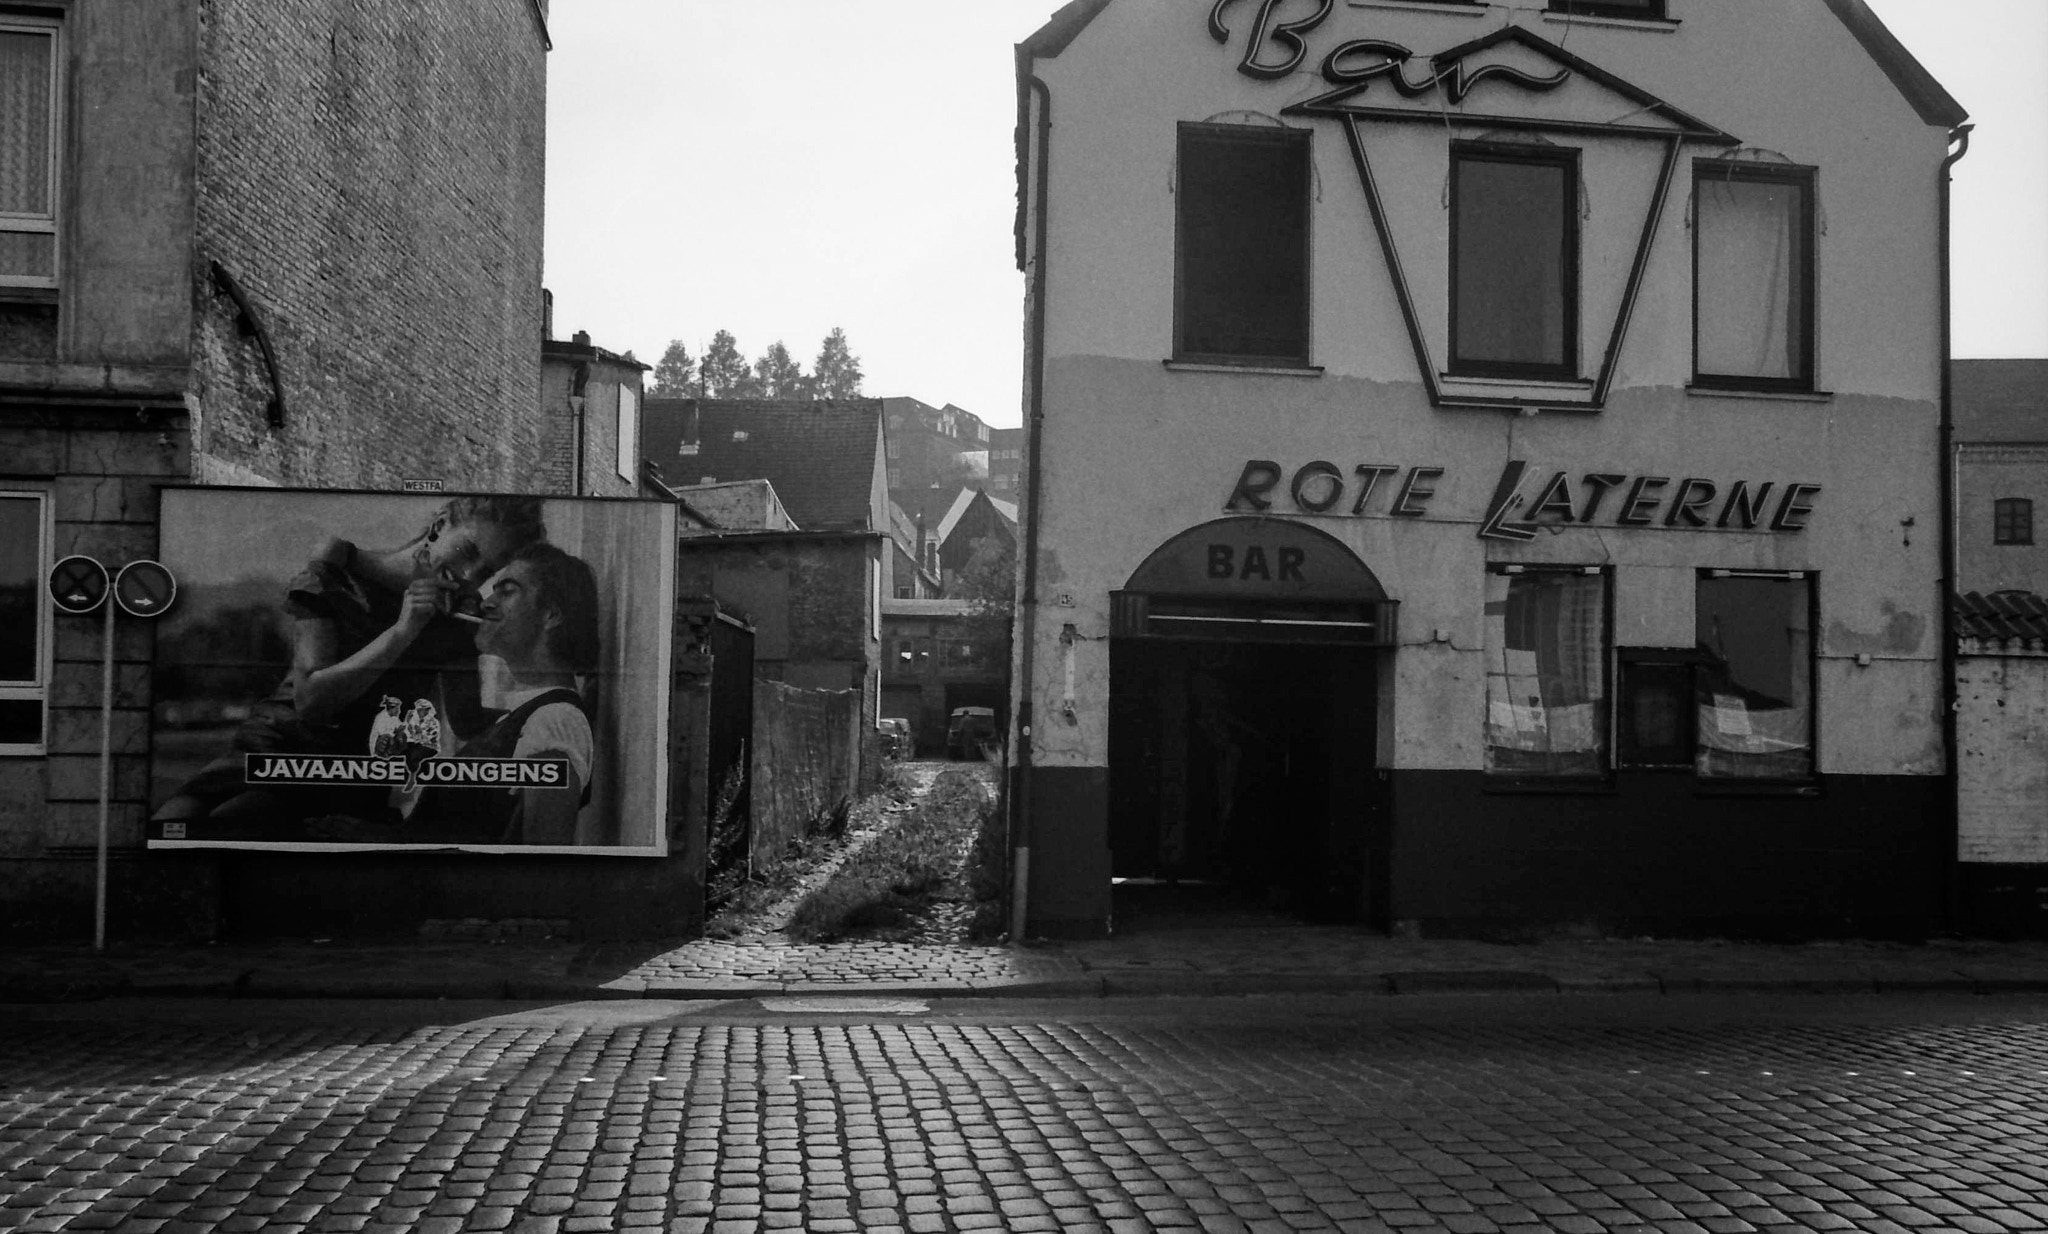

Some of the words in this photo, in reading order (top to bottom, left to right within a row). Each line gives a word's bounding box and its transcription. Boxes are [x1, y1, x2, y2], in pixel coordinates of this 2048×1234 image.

[1208, 0, 1572, 104] Bar
[405, 481, 441, 491] WESTFA
[1224, 459, 1445, 517] ROTE
[1477, 460, 1822, 542] LATERNE
[1207, 544, 1306, 582] BAR
[254, 757, 406, 781] JAVAANSE
[418, 761, 560, 784] JONGENS
